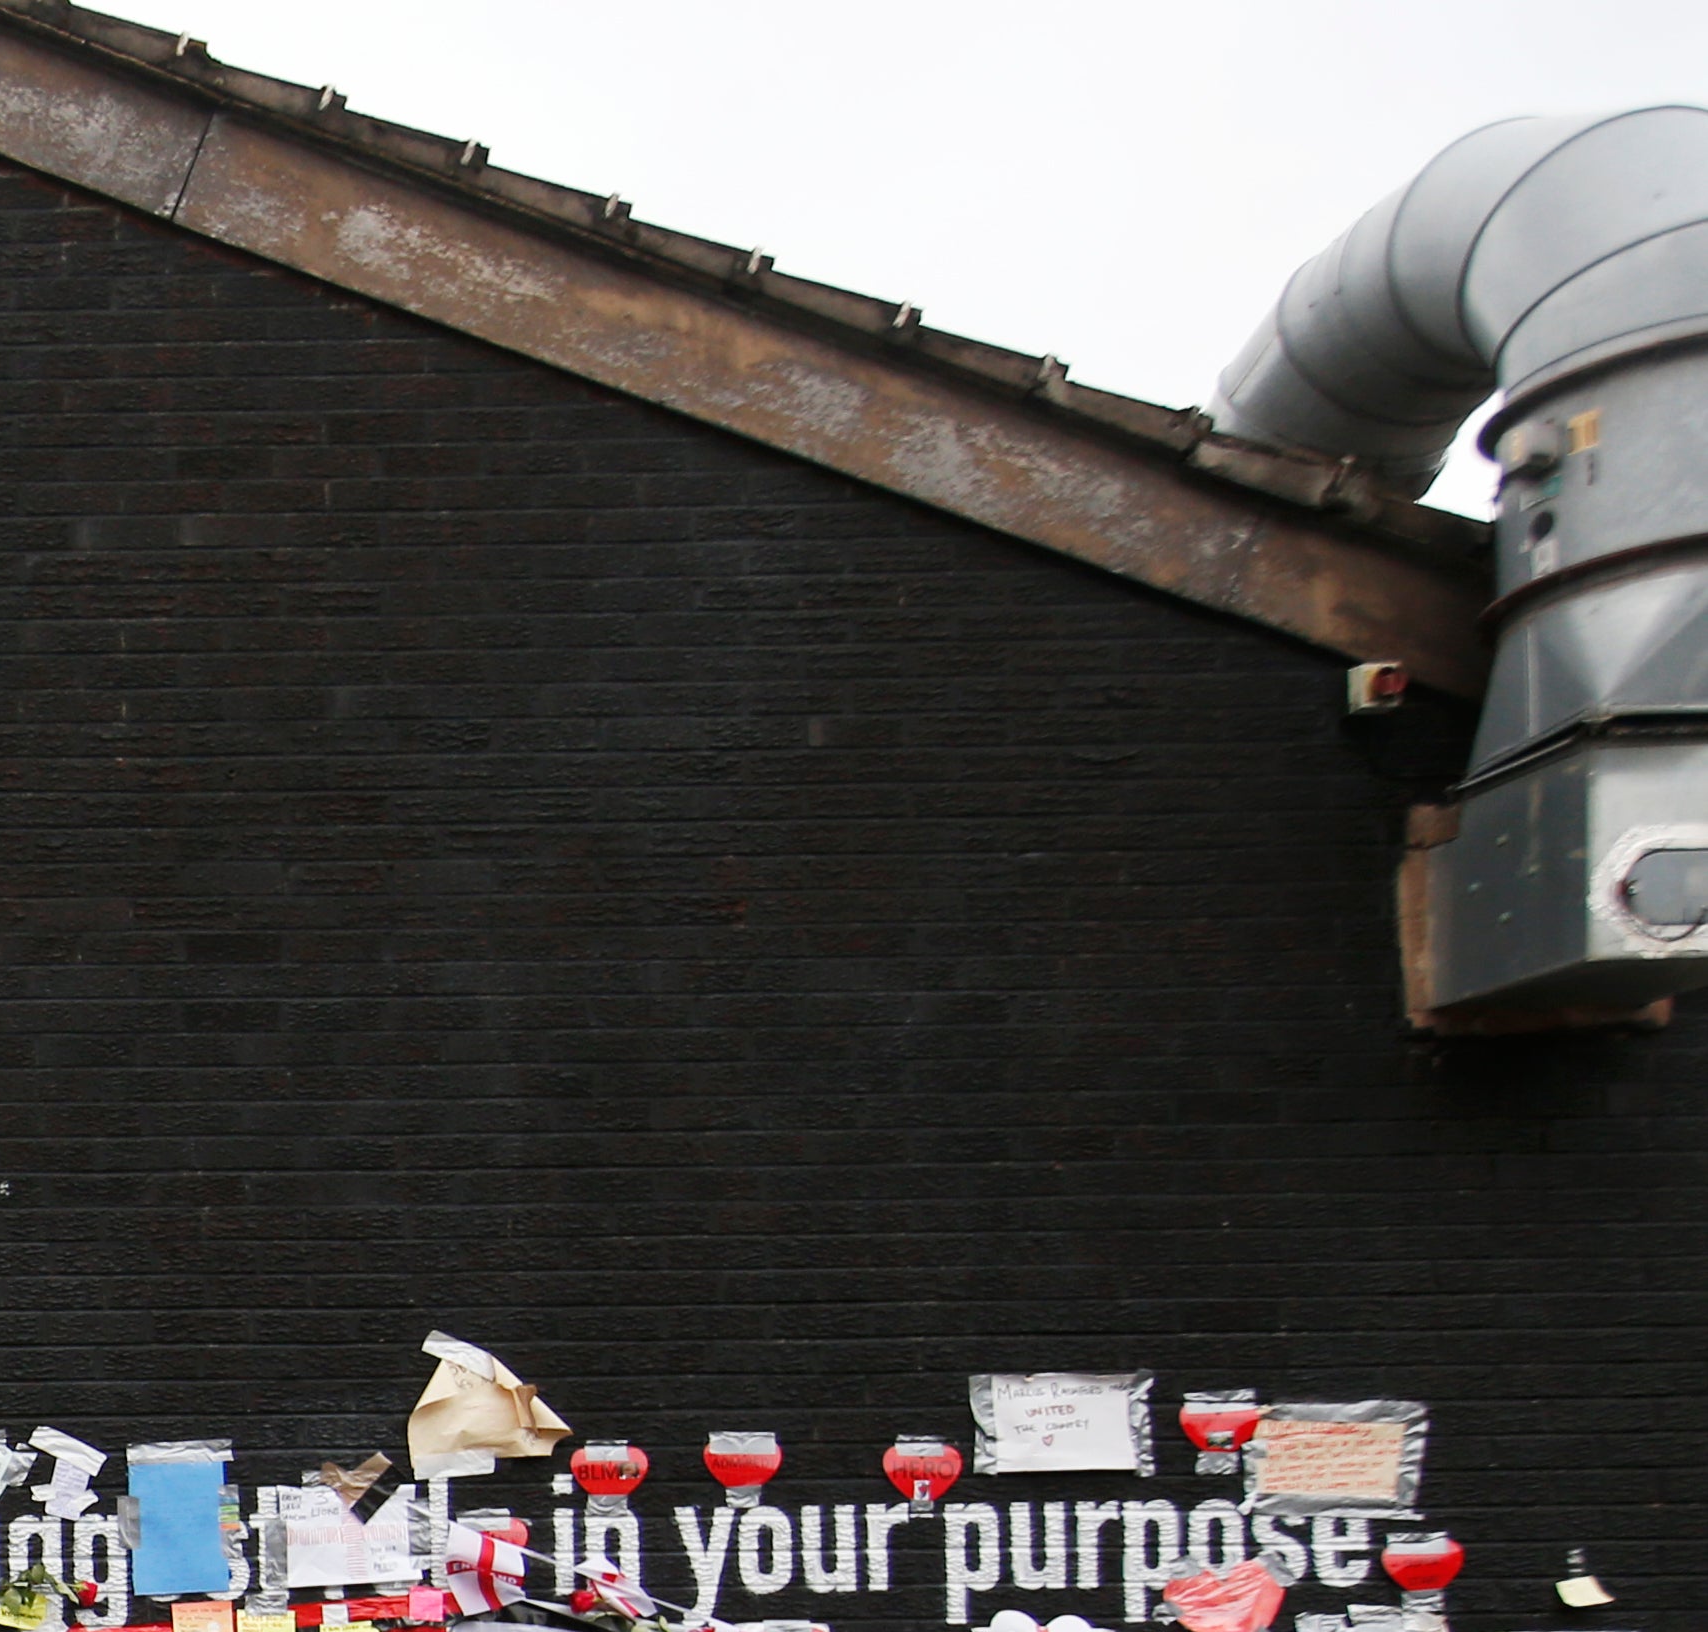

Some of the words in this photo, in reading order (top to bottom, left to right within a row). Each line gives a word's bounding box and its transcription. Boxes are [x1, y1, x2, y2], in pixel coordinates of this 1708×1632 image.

[1024, 1403, 1076, 1418] UNITED
[892, 1459, 956, 1481] HERO
[552, 1474, 644, 1598] in
[674, 1500, 913, 1615] your
[942, 1497, 1371, 1625] purpose
